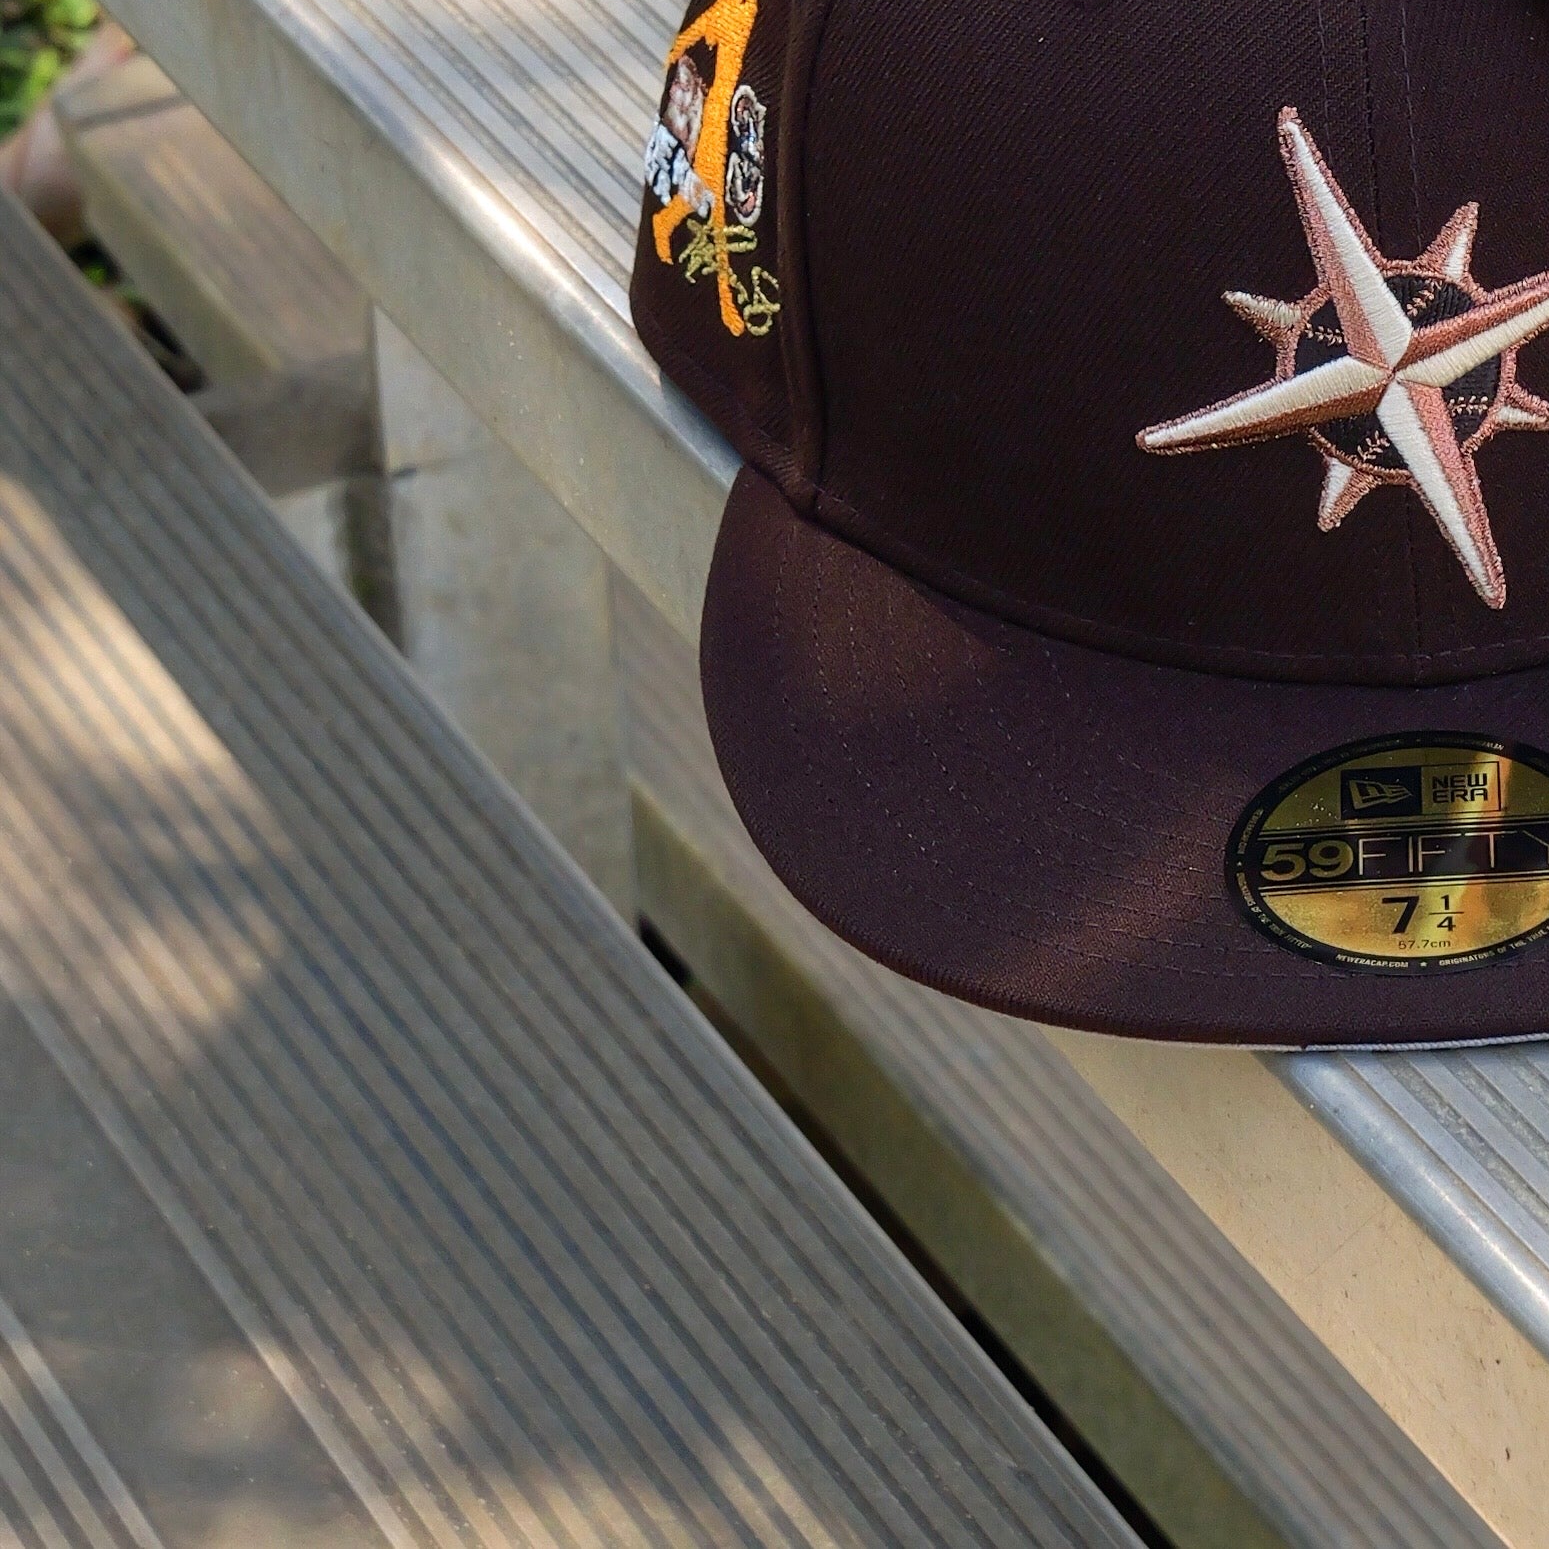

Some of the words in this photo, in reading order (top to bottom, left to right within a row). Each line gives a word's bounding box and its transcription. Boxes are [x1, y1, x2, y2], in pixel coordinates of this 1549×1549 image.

[1432, 773, 1488, 789] NEW
[1432, 788, 1488, 803] ERA
[1382, 895, 1420, 934] 7
[1335, 954, 1409, 968] NEWERACAP.COM
